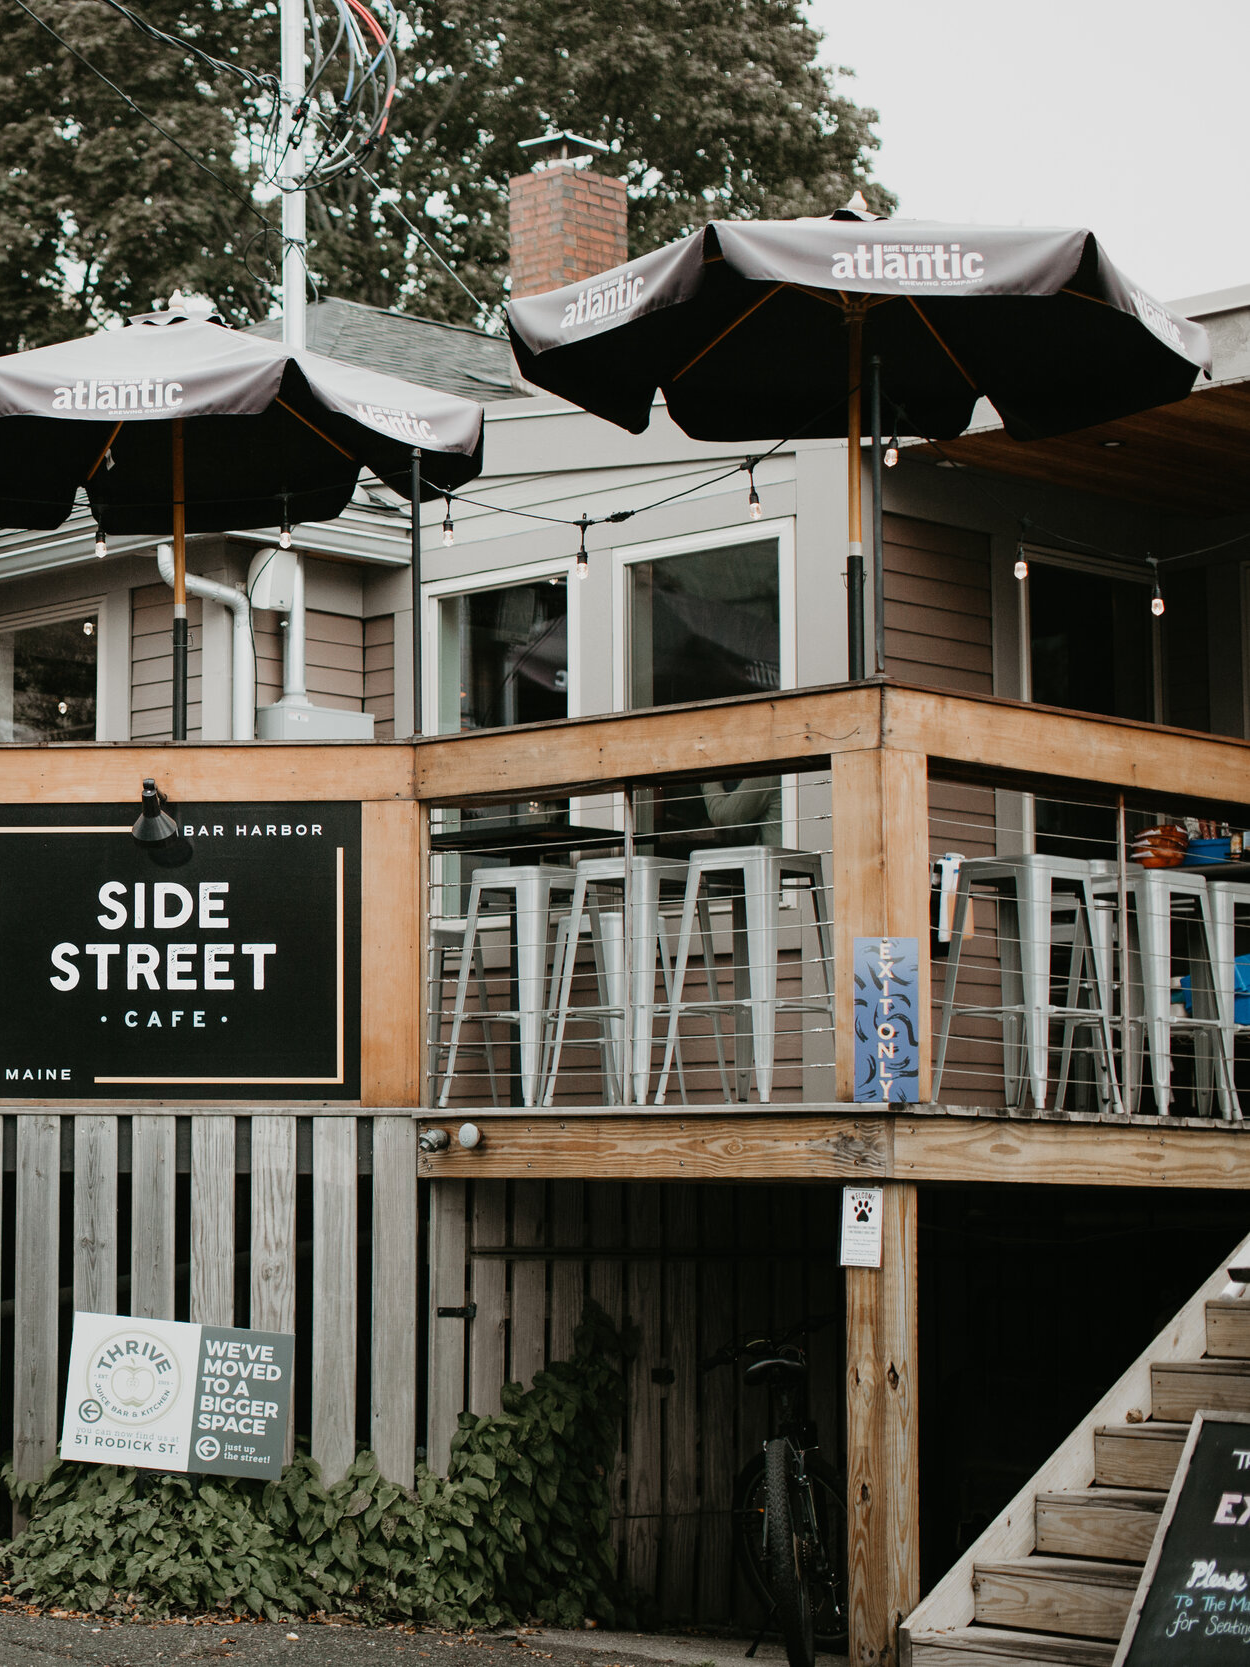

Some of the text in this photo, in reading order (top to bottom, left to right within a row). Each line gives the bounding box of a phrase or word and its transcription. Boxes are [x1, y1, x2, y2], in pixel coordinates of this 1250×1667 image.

[883, 245, 900, 253] SAVE
[901, 245, 914, 253] THE
[831, 244, 985, 280] atlantic
[941, 278, 984, 287] COMPANY
[560, 271, 645, 329] atlantic
[51, 378, 184, 410] atlantic
[183, 824, 323, 837] BAR HARBOR
[97, 881, 229, 930] SIDE
[50, 942, 277, 991] STREET
[124, 1010, 206, 1028] CAFE
[877, 943, 896, 1100] EXIT ONLY
[5, 1068, 72, 1081] MAINE
[97, 1340, 172, 1375] THRIVE
[205, 1339, 275, 1363] WE'VE
[203, 1358, 282, 1382] MOVED
[201, 1376, 250, 1397] TO A
[94, 1382, 111, 1406] JUICE
[111, 1405, 129, 1417] BAR
[141, 1389, 171, 1417] KITCHEN
[199, 1395, 279, 1419] BIGGER
[76, 1426, 180, 1443] you can now find us at
[197, 1413, 267, 1436] SPACE
[75, 1434, 179, 1455] 51 RODICK ST.
[223, 1442, 256, 1455] just up
[223, 1451, 271, 1464] the street!
[1186, 1559, 1248, 1592] Please
[1174, 1594, 1194, 1610] To
[1201, 1595, 1227, 1612] The
[1165, 1611, 1200, 1638] for
